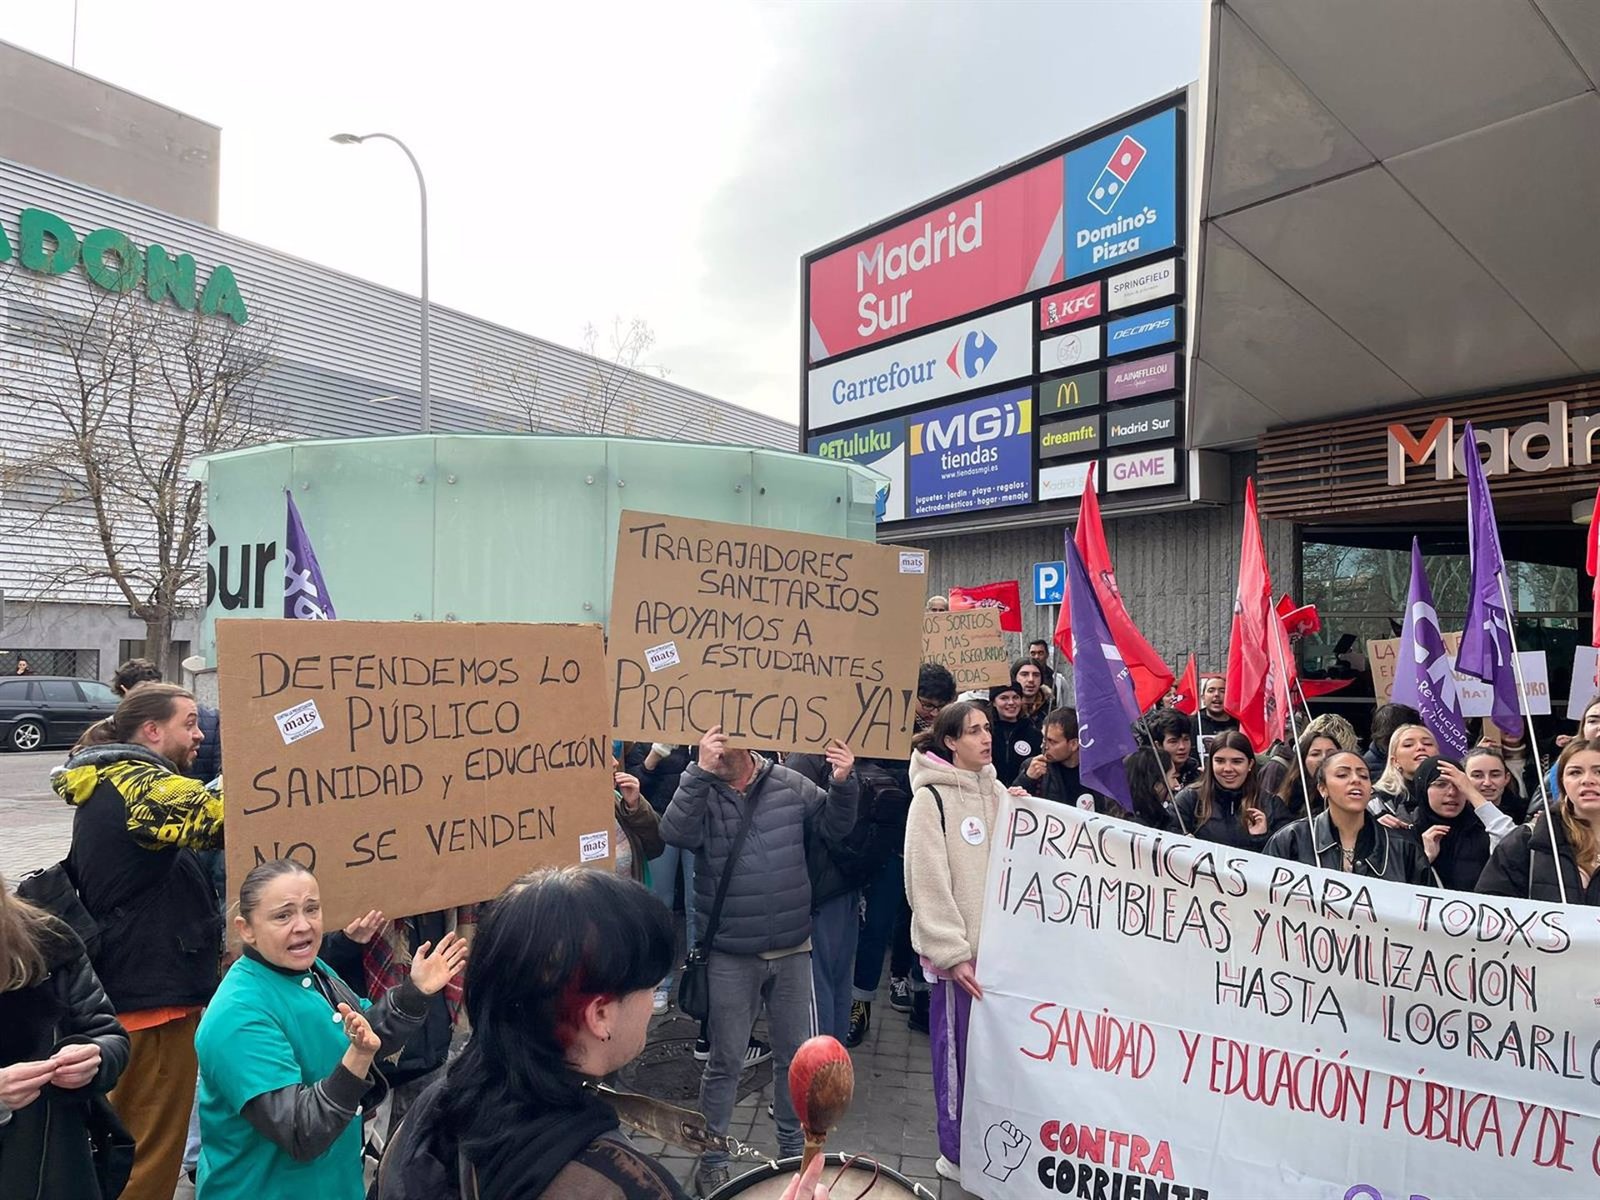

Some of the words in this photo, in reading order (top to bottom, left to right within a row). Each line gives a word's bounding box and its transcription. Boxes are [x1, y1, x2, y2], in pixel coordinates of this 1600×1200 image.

[857, 200, 983, 293] Madrid
[1077, 206, 1157, 248] Domino's
[0, 208, 249, 325] DONA
[1093, 235, 1140, 264] Pizza
[1113, 270, 1170, 293] SPRINGFIELD
[857, 287, 912, 338] Sur
[1062, 293, 1096, 317] KFC
[1113, 318, 1171, 340] DECIMAS
[832, 356, 936, 405] Carrefour
[1111, 421, 1148, 437] Madrid
[1151, 418, 1170, 431] Sur
[941, 444, 998, 470] tiendas
[1113, 457, 1165, 480] GAME
[915, 493, 943, 506] juguetes
[971, 485, 992, 497] playa
[996, 480, 1024, 493] regalos
[977, 495, 997, 507] hogar
[1001, 491, 1029, 503] menaje
[629, 523, 852, 582] TRABAJADORES
[698, 569, 879, 616] SANITARIOS
[1039, 567, 1058, 599] P
[635, 600, 784, 642] APOYAMOS
[793, 618, 813, 646] A
[945, 612, 994, 632] SORTEOS
[251, 652, 520, 699] DEFENDEMOS
[539, 655, 580, 686] LO
[650, 650, 675, 663] mats
[702, 643, 884, 682] ESTUDIANTES
[284, 711, 316, 731] mats
[345, 696, 520, 752] PÚBLICO
[244, 764, 424, 815] SANIDAD
[465, 734, 607, 782] EDUCACIÓN
[345, 828, 397, 868] SE
[425, 806, 556, 855] VENDEN
[583, 841, 606, 852] mats
[1006, 807, 1249, 897] PRÁCTICAS
[1269, 866, 1378, 923] PARA
[1415, 893, 1571, 954] TODXS
[1251, 908, 1271, 955] Y
[1216, 961, 1348, 1034] HASTA
[1020, 1002, 1157, 1079] SANIDAD
[1178, 1029, 1202, 1083] Y
[1209, 1036, 1371, 1124] EDUCACIÓN
[1383, 1068, 1503, 1157] PÚBLICA
[1510, 1101, 1537, 1156] Y
[1533, 1106, 1581, 1172] DE
[1040, 1120, 1175, 1180] CONTRA
